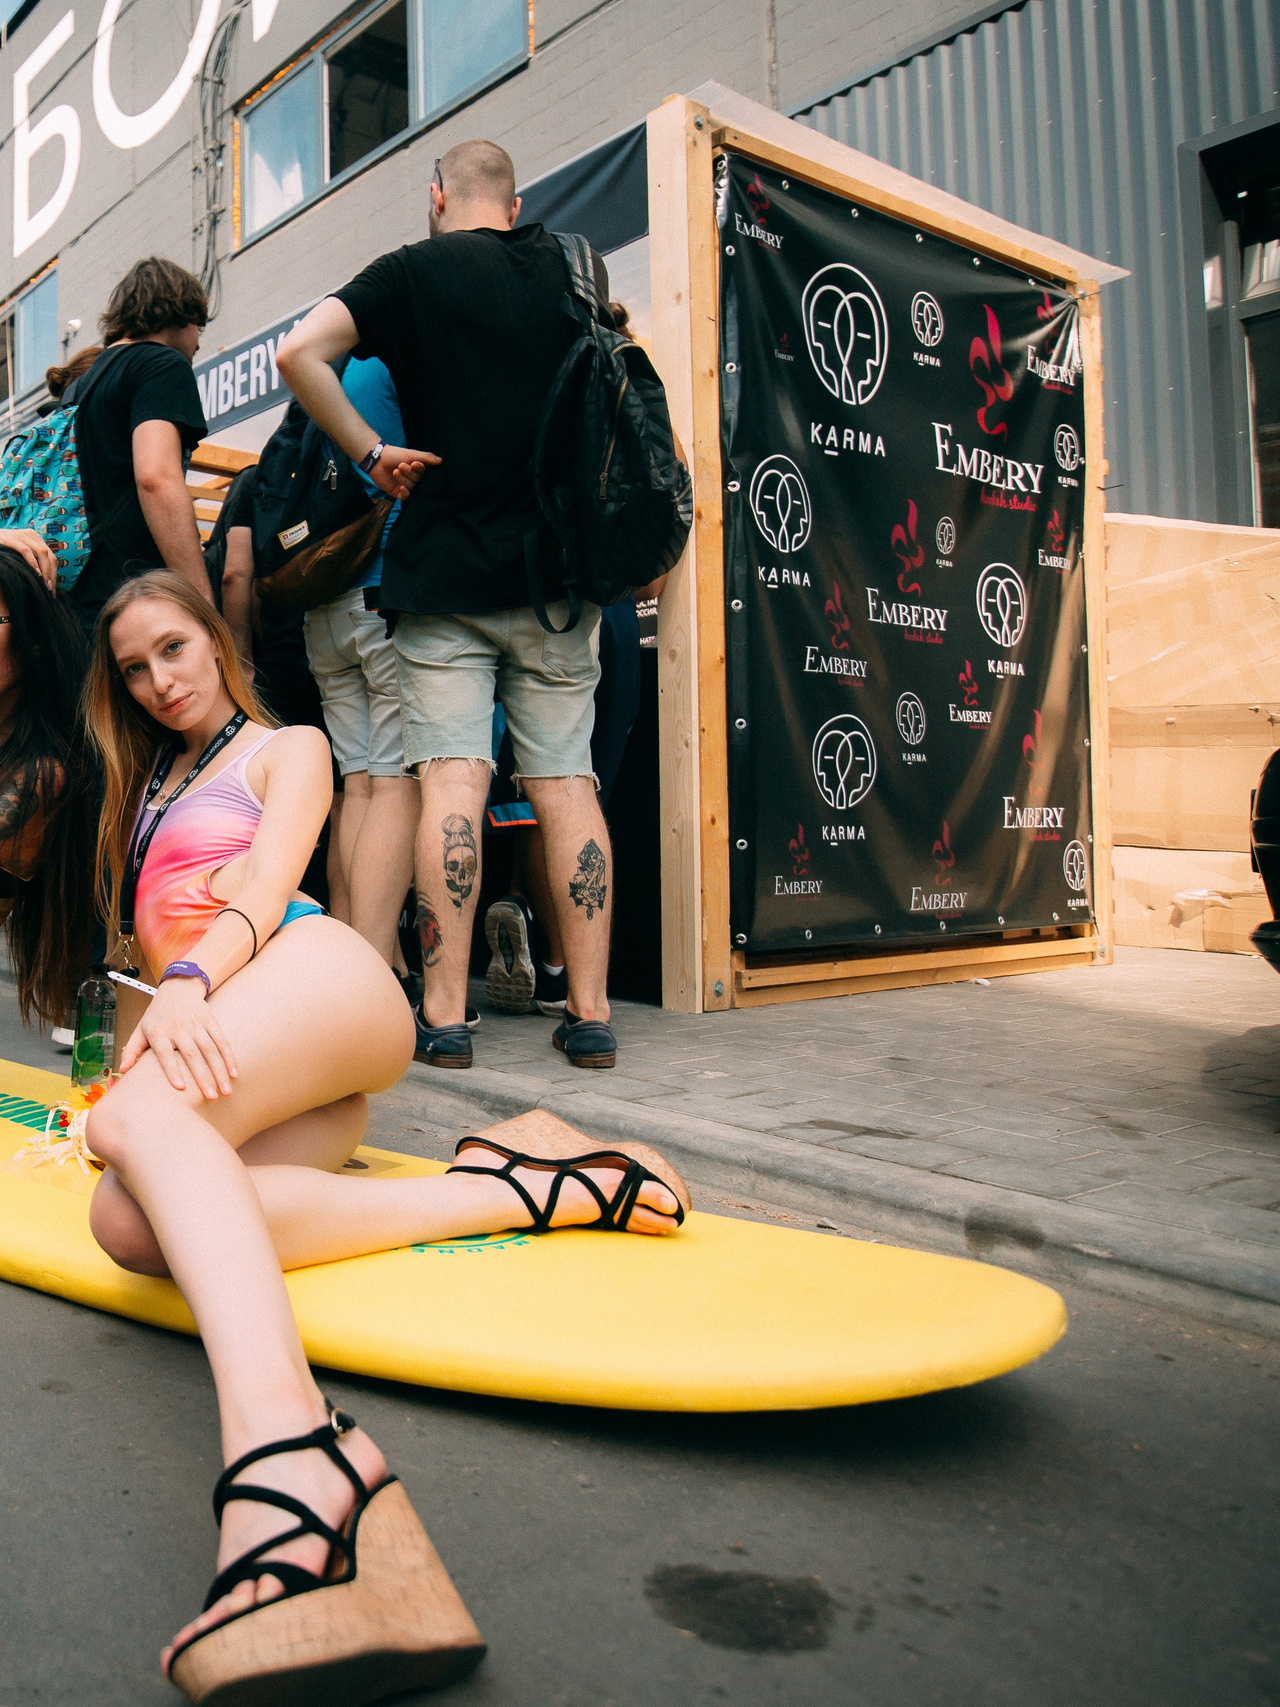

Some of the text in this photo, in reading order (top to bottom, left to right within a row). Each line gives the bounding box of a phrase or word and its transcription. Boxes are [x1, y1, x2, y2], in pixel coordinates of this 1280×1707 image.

[734, 212, 784, 249] EMBERY
[913, 351, 941, 367] KARMA
[197, 331, 287, 421] MBERY
[810, 422, 886, 457] KARMA
[931, 422, 1045, 493] EMBERY
[1057, 475, 1079, 488] KARMA
[936, 558, 953, 568] KARMA
[758, 566, 811, 588] KARMA
[866, 587, 949, 631] EMBERY
[803, 646, 868, 677] EMBERY
[987, 659, 1025, 678] KARMA
[949, 704, 992, 723] EMBERY
[903, 753, 927, 764] KARMA
[1003, 797, 1065, 829] EMBERY
[822, 826, 866, 845] KARMA
[774, 876, 823, 895] EMBERY
[910, 887, 968, 911] EMBERY
[1067, 898, 1089, 909] KARMA
[391, 1239, 531, 1254] MADNE
